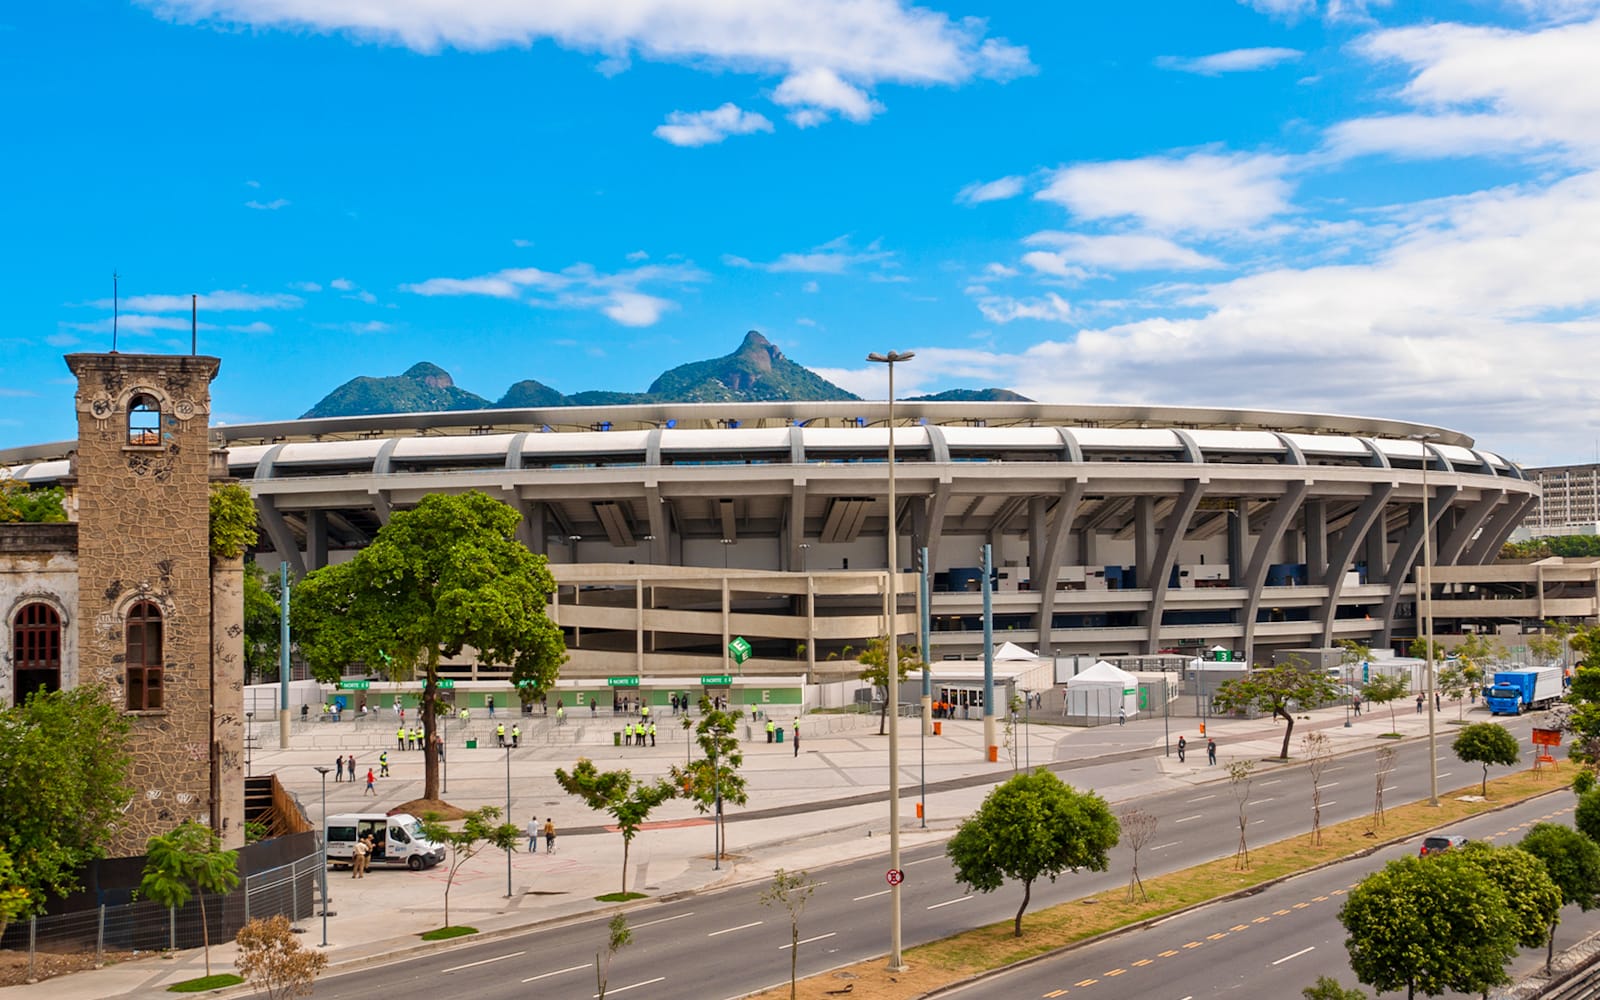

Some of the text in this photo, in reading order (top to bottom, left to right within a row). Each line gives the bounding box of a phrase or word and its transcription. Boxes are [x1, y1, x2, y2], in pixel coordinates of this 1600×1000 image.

[733, 640, 746, 651] E
[1221, 652, 1227, 661] 3
[576, 692, 584, 705] E
[762, 690, 770, 702] E
[1138, 687, 1147, 709] 3
